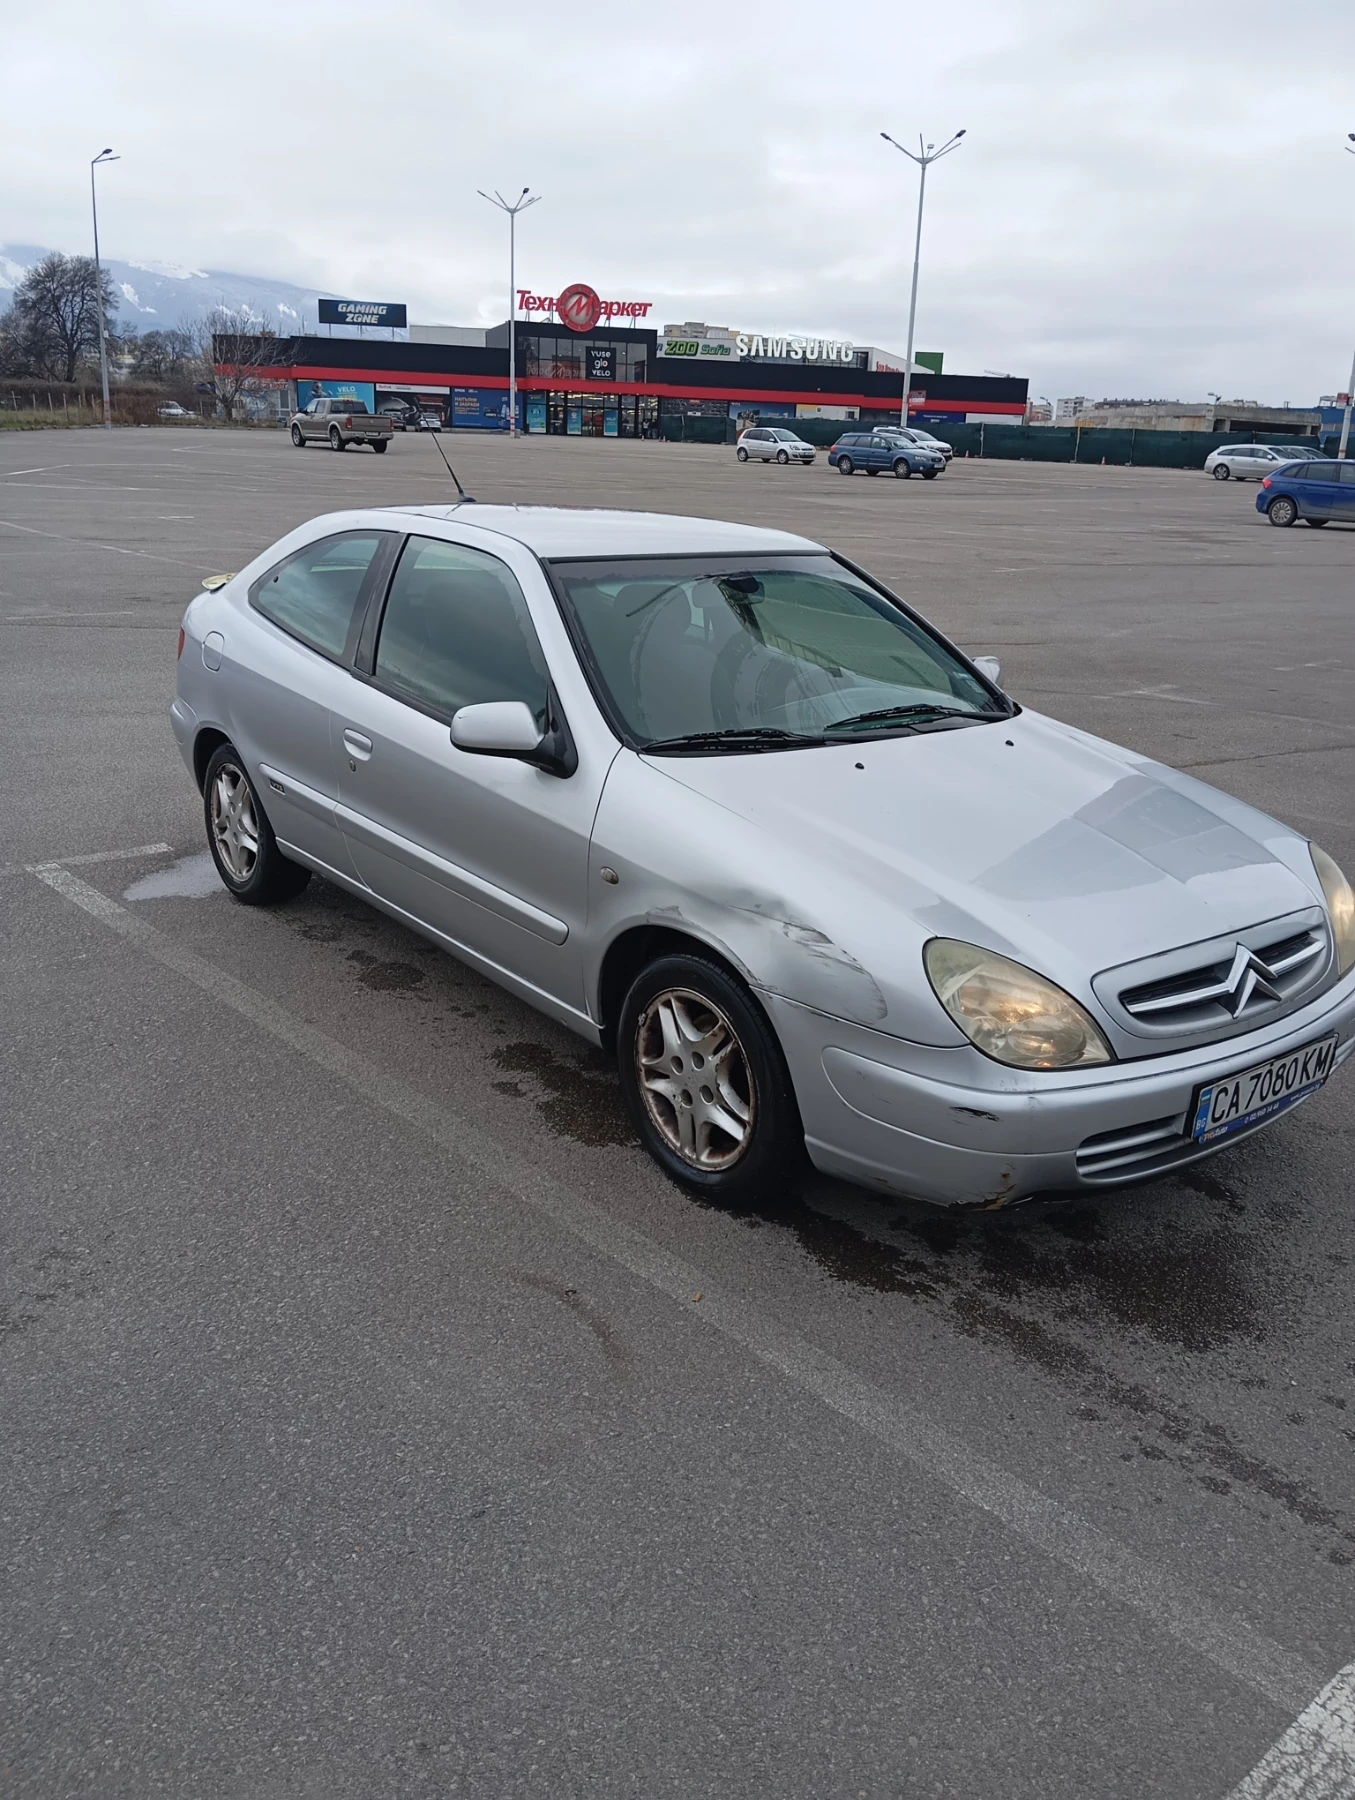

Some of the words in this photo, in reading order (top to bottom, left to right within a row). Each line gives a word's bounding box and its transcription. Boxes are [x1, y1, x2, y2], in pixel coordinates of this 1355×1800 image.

[337, 303, 388, 315] GAMING
[345, 313, 380, 324] ZONE
[664, 340, 699, 356] ZOO
[700, 343, 731, 356] Sofia
[735, 334, 854, 362] SAMSUNG
[594, 358, 608, 369] glo
[591, 369, 611, 377] VELO
[337, 385, 356, 393] VELO
[1211, 1080, 1240, 1124] CA
[1244, 1057, 1299, 1111] 7080
[1299, 1043, 1332, 1085] KM
[1195, 1116, 1207, 1131] BG
